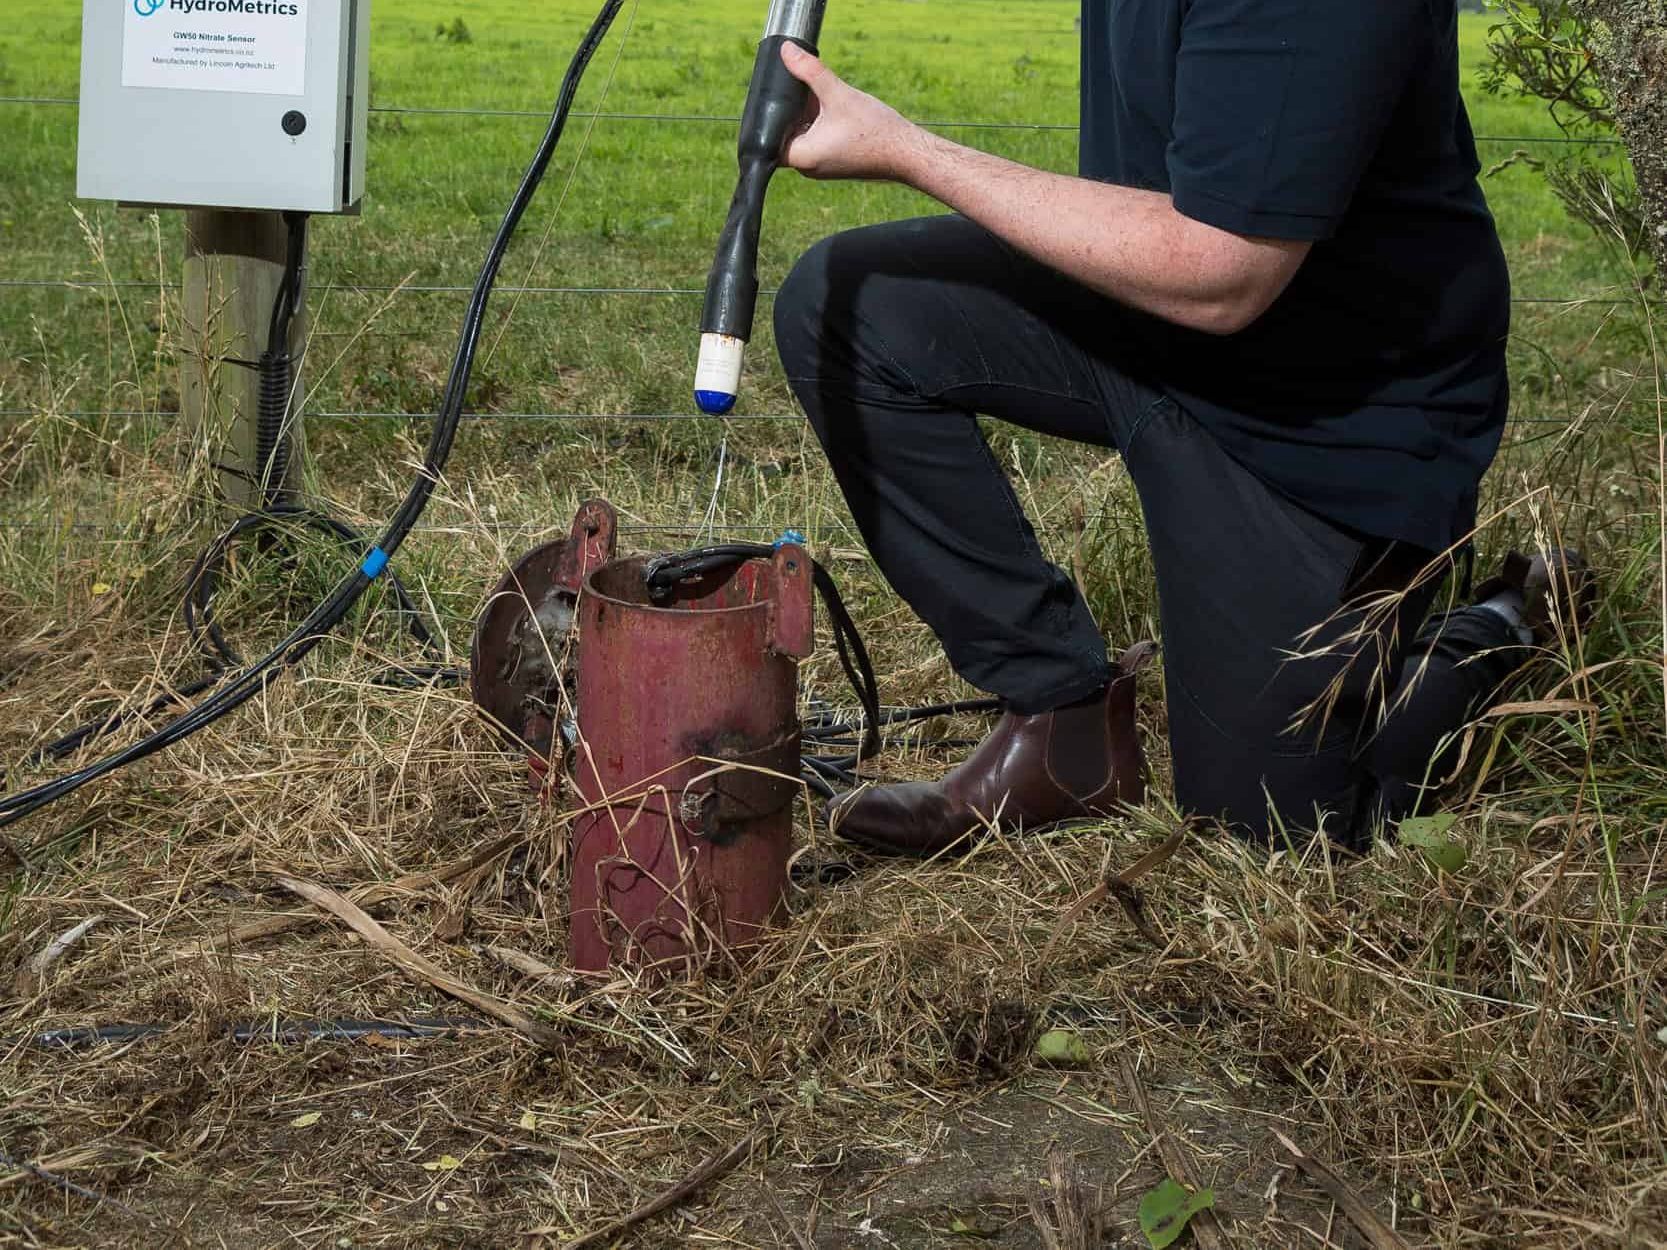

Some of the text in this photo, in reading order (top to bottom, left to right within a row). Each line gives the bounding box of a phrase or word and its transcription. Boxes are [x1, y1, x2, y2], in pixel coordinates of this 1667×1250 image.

[173, 31, 256, 43] GW50 Nitrate Sensor
[152, 56, 198, 66] Manufactured
[199, 59, 208, 68] by
